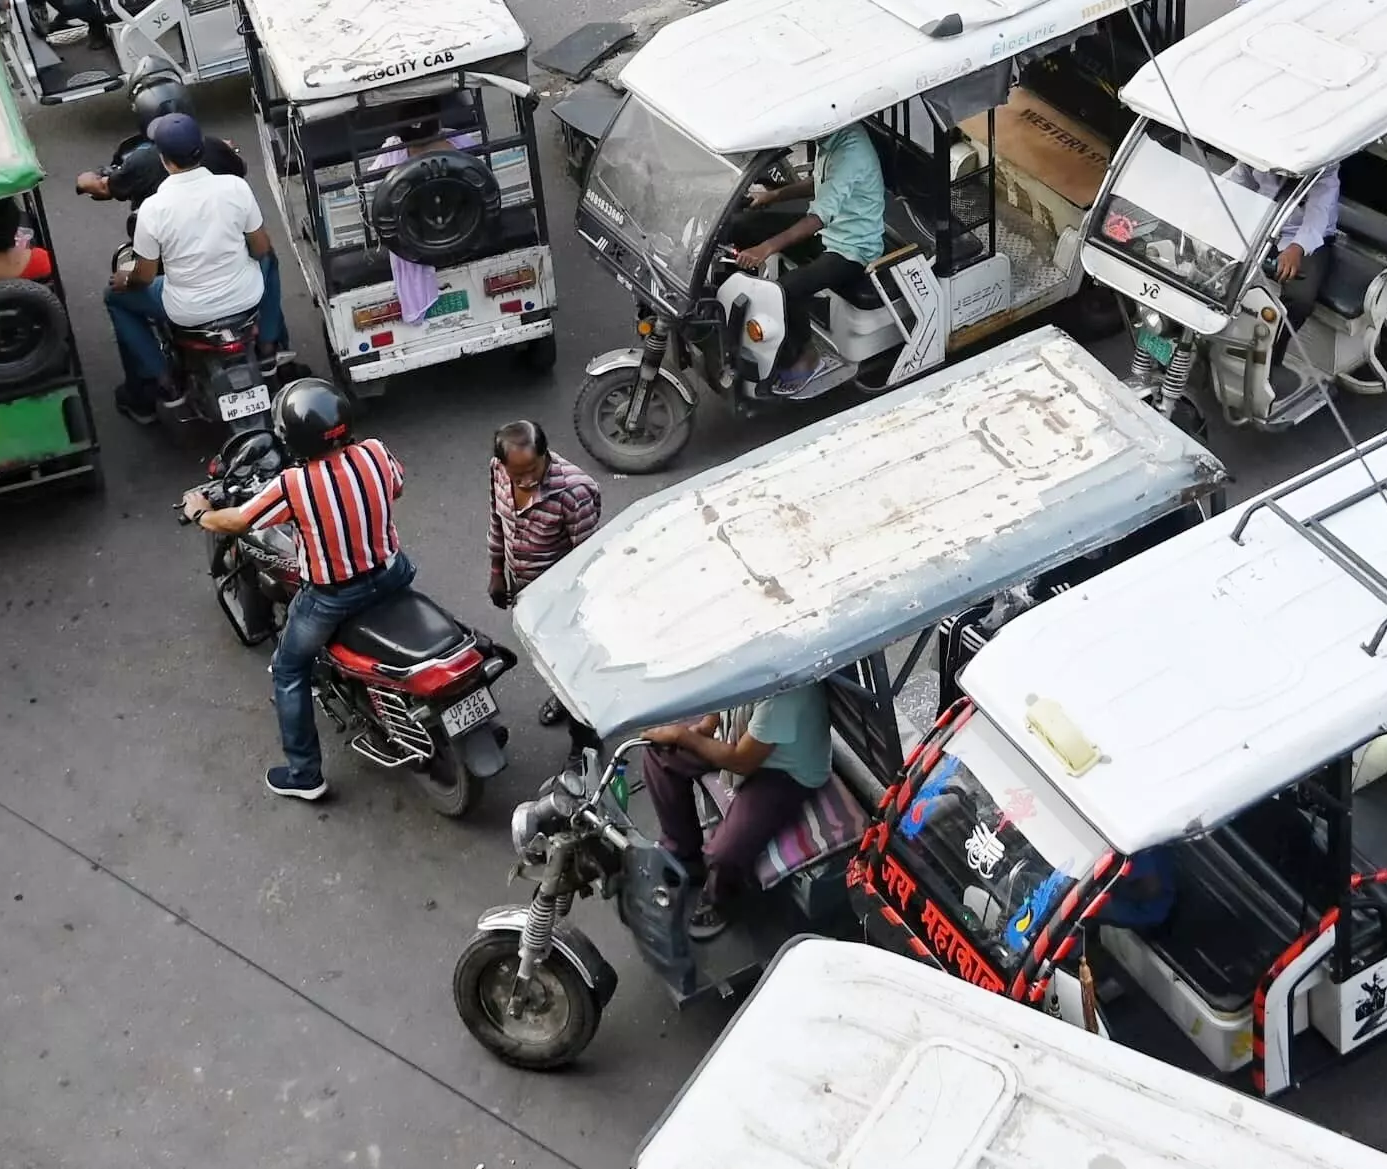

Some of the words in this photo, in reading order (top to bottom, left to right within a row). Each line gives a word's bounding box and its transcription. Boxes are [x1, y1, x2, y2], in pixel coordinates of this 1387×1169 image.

[989, 23, 1057, 58] Electric
[423, 51, 455, 68] CAB
[1020, 108, 1090, 156] WESTERN
[245, 401, 266, 414] 5343
[449, 691, 485, 719] UP32C
[881, 855, 916, 911] जय
[921, 898, 1005, 993] महाकाल
